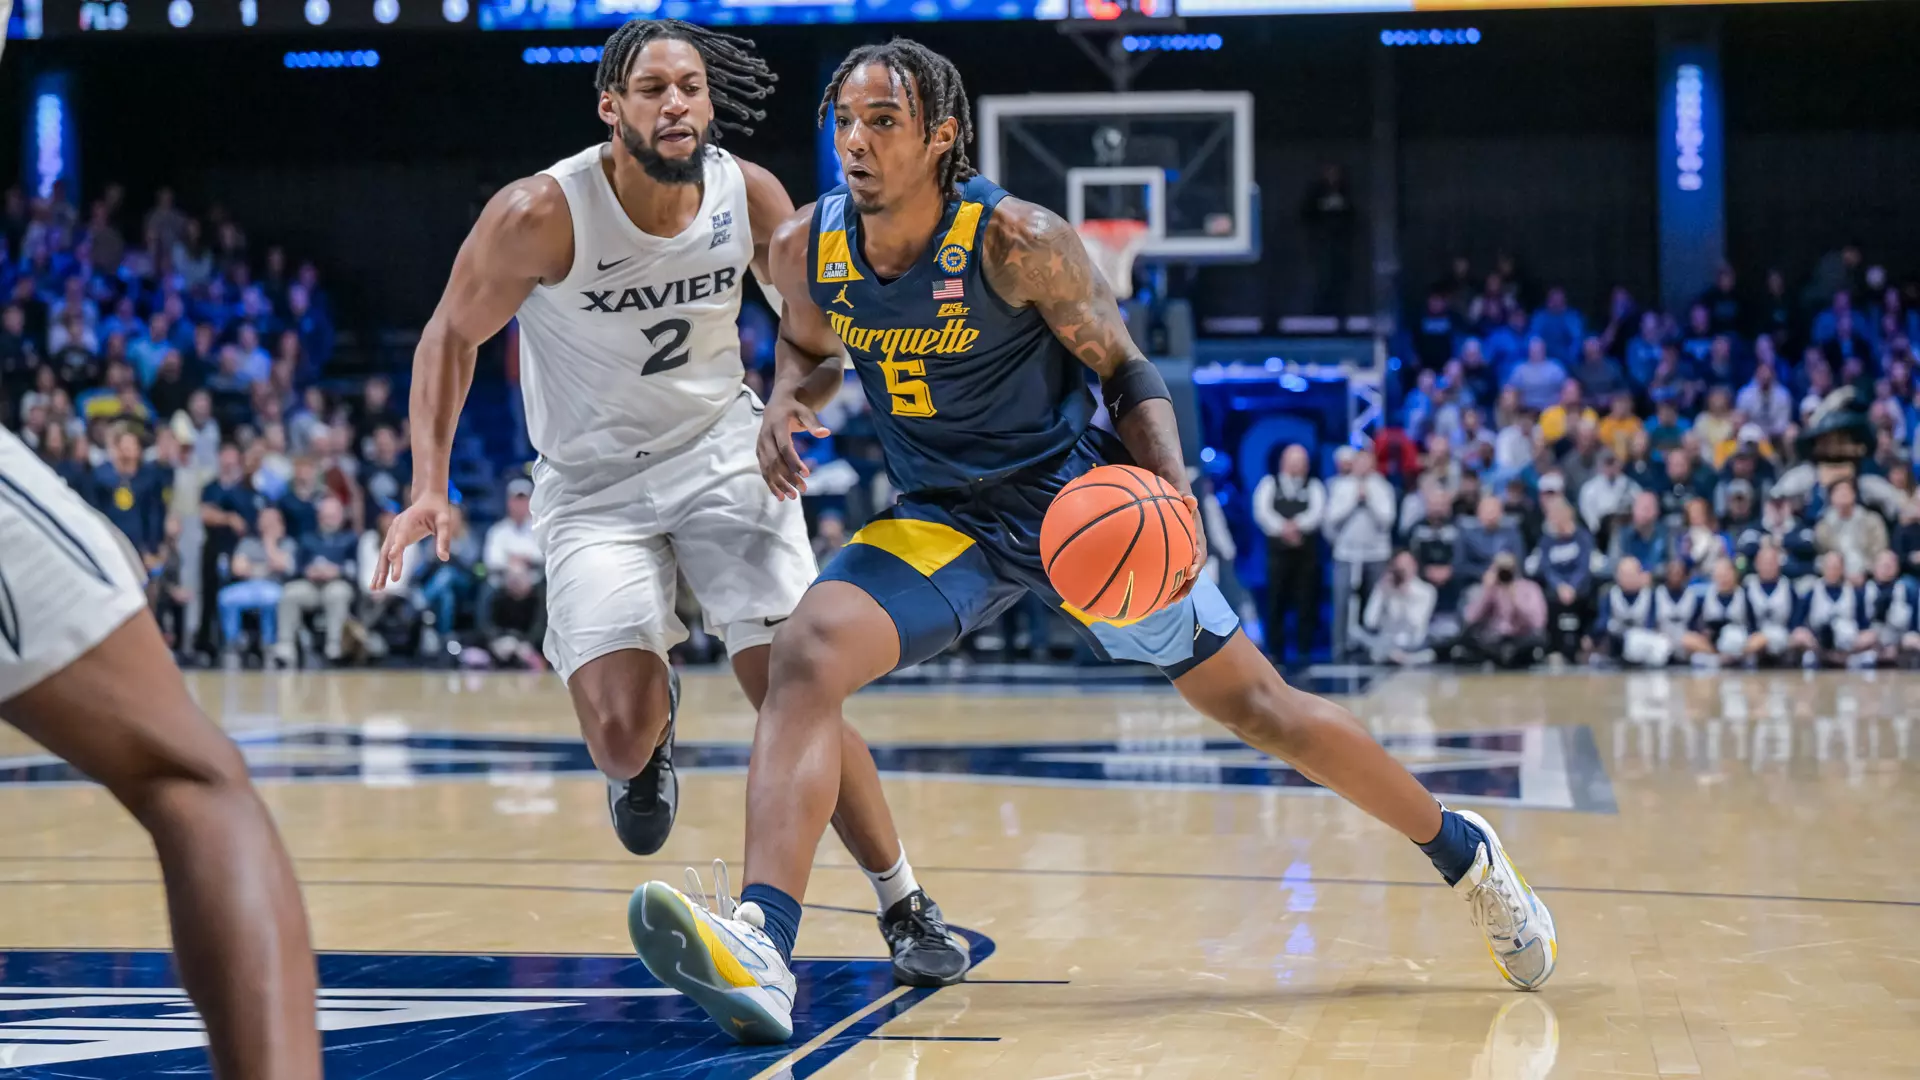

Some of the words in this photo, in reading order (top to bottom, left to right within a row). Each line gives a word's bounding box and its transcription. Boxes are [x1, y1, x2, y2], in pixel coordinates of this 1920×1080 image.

[580, 266, 736, 313] XAVIER
[823, 269, 848, 278] CHANGE
[825, 263, 833, 271] BE
[835, 262, 847, 270] THE
[936, 307, 970, 317] EAST
[640, 317, 694, 377] 2
[826, 310, 980, 362] Marquette
[877, 359, 938, 418] 5
